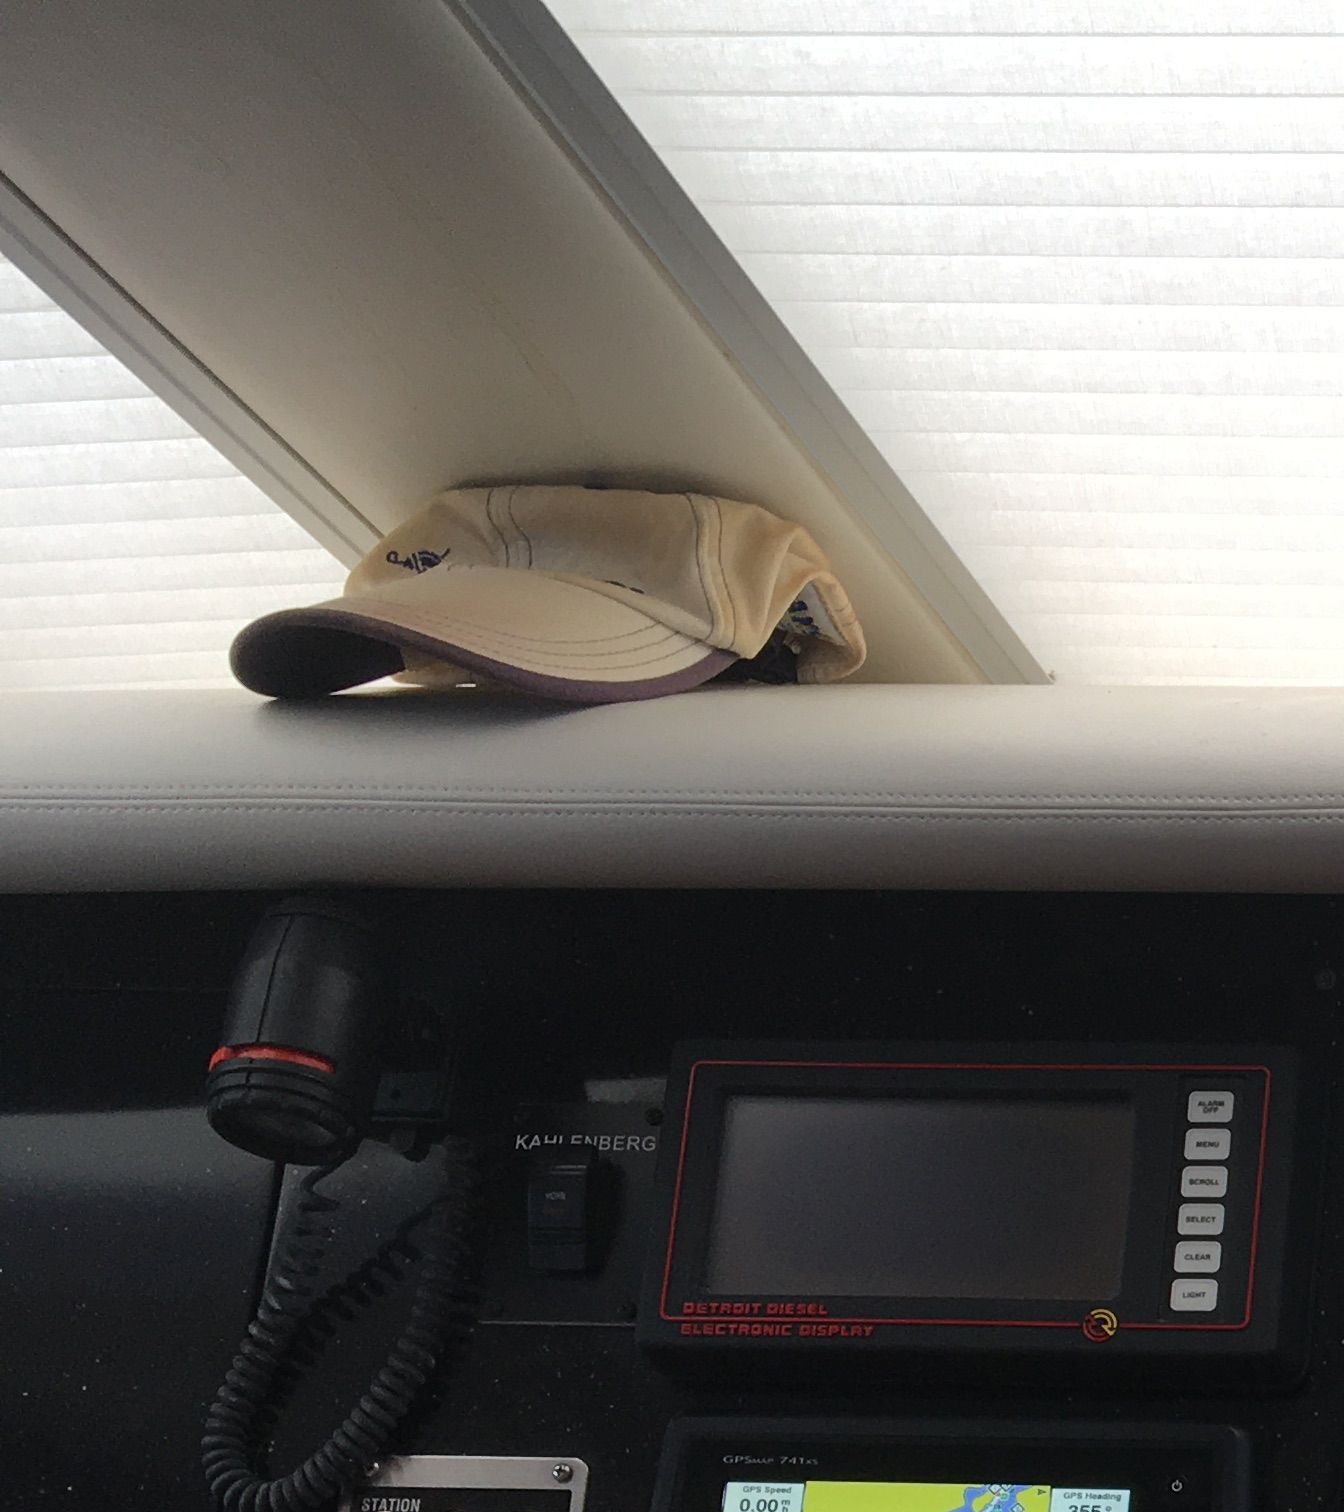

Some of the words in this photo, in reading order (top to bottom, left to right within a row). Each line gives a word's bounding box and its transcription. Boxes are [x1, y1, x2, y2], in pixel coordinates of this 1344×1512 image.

[683, 1302, 760, 1314] DETROIT
[767, 1303, 827, 1315] DIESEL
[681, 1323, 792, 1337] ELECTRONIC
[799, 1324, 874, 1337] DISPLAY
[764, 1486, 791, 1495] Speed
[1085, 1492, 1122, 1501] Heading
[361, 1498, 421, 1512] STATION
